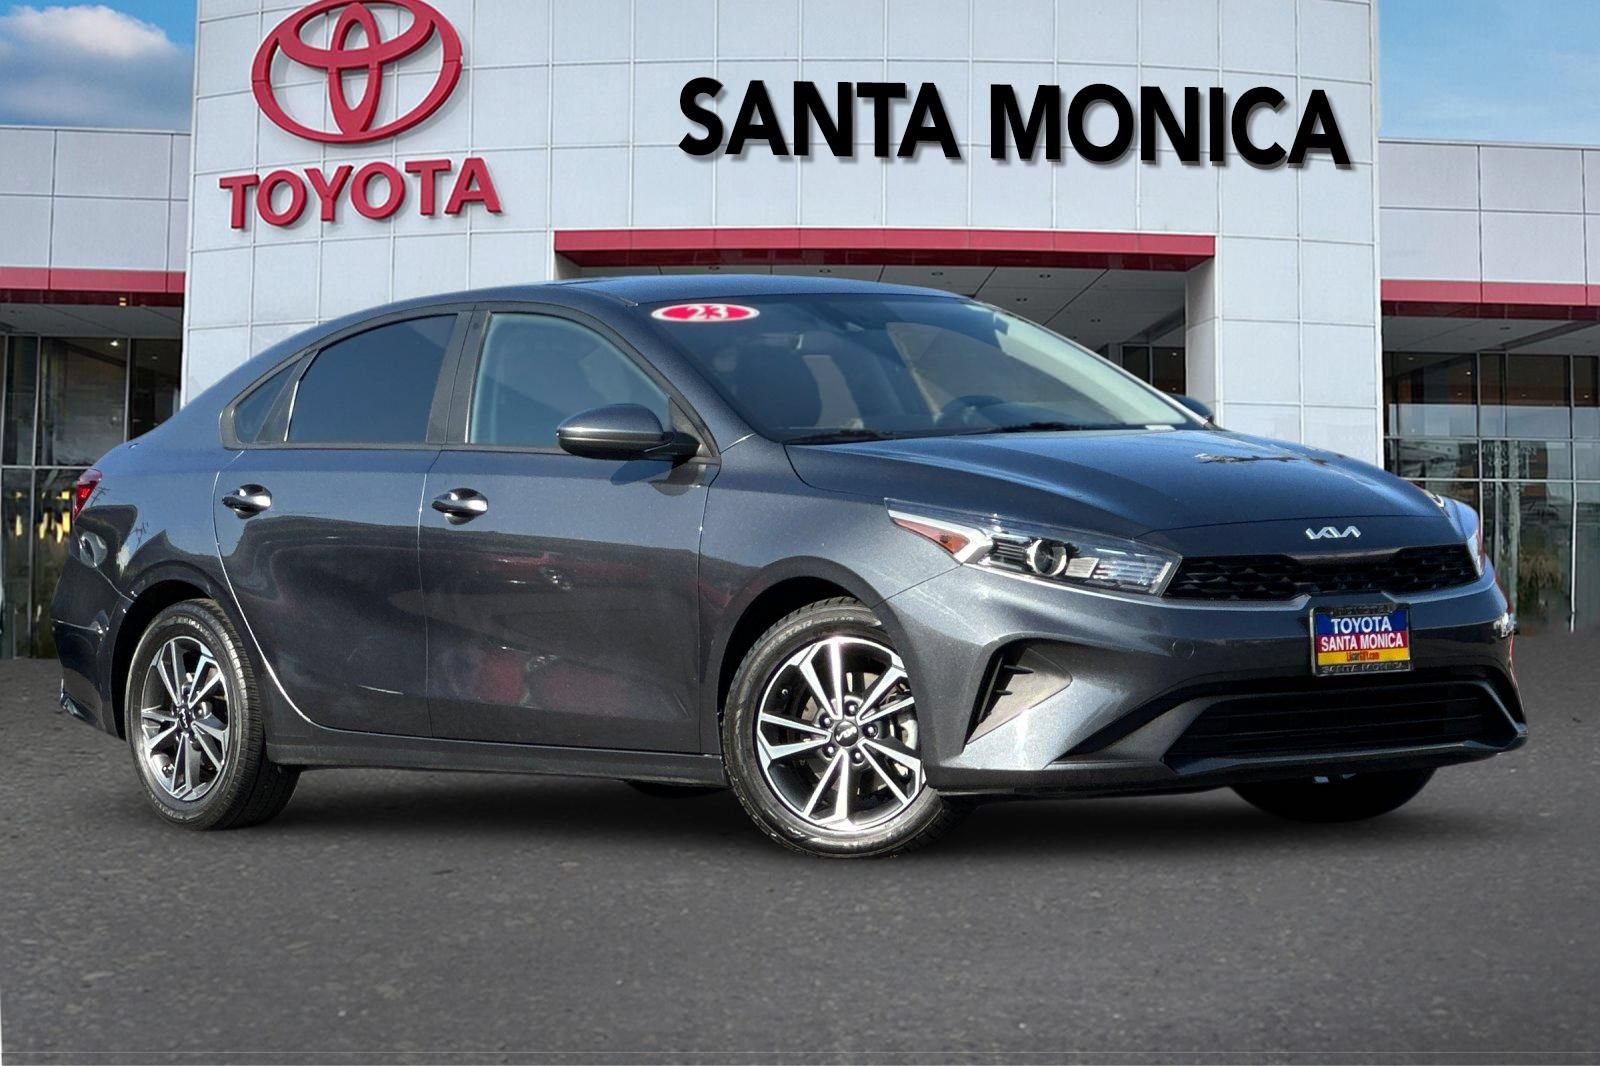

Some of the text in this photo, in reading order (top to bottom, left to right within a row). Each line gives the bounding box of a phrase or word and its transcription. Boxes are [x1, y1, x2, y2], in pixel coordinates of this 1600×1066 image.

[678, 76, 1353, 169] SANTA MONICA
[219, 157, 502, 230] TOYOTA
[687, 303, 729, 321] 23
[1305, 525, 1362, 540] KIA
[1330, 615, 1393, 635] TOYOTA
[1321, 632, 1404, 652] SANTA MONICA
